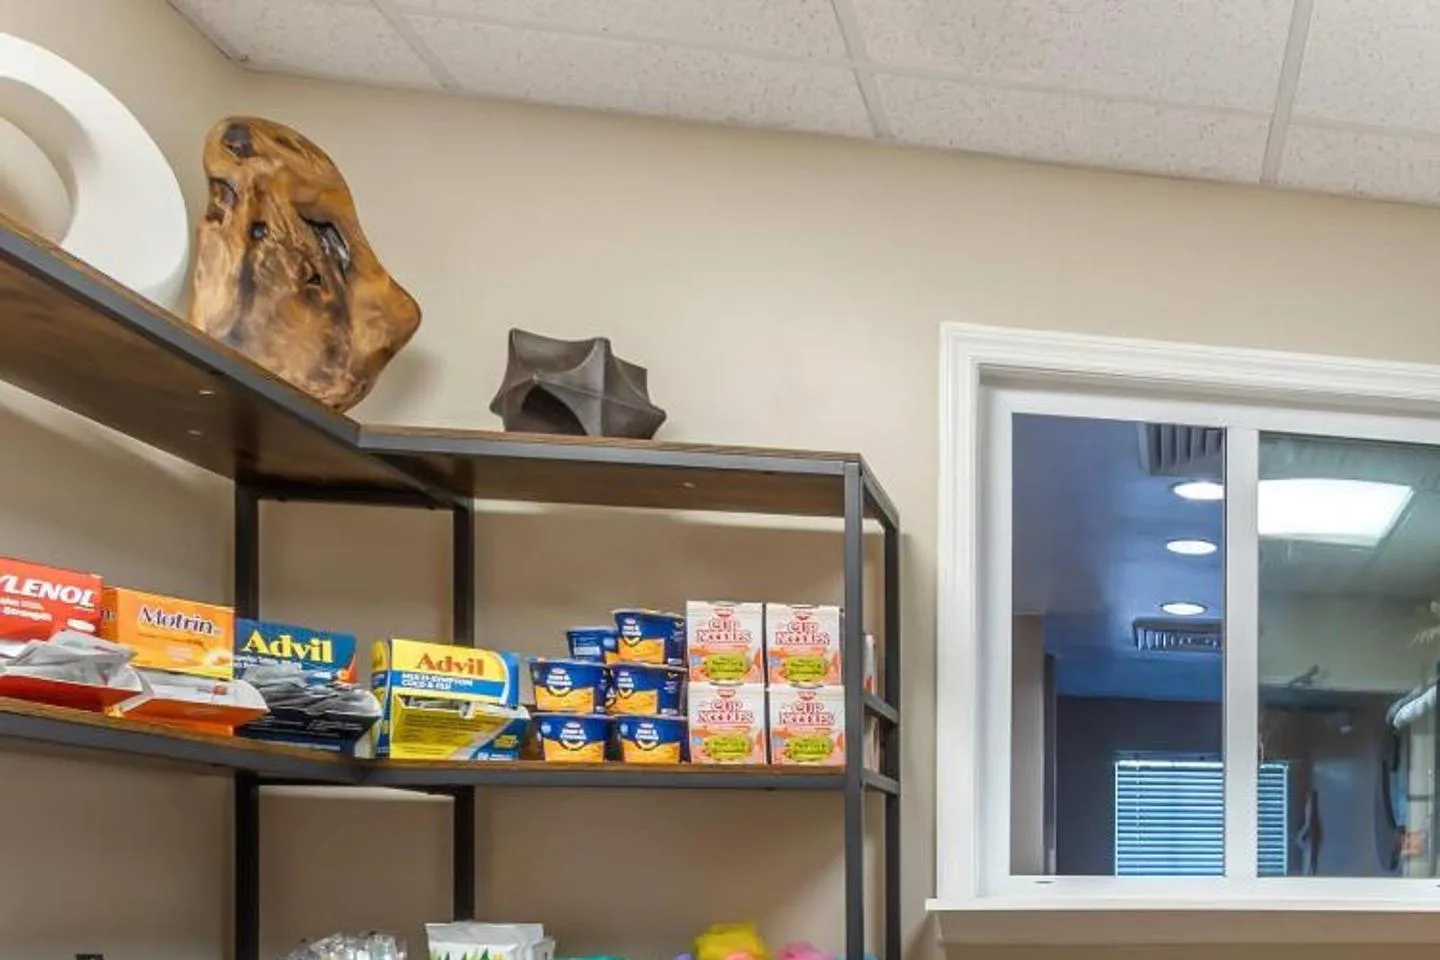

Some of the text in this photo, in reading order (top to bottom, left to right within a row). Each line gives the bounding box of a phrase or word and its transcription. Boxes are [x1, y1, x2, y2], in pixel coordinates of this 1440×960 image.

[139, 605, 214, 635] Motrin
[240, 630, 333, 663] Advil
[416, 653, 485, 676] Advil
